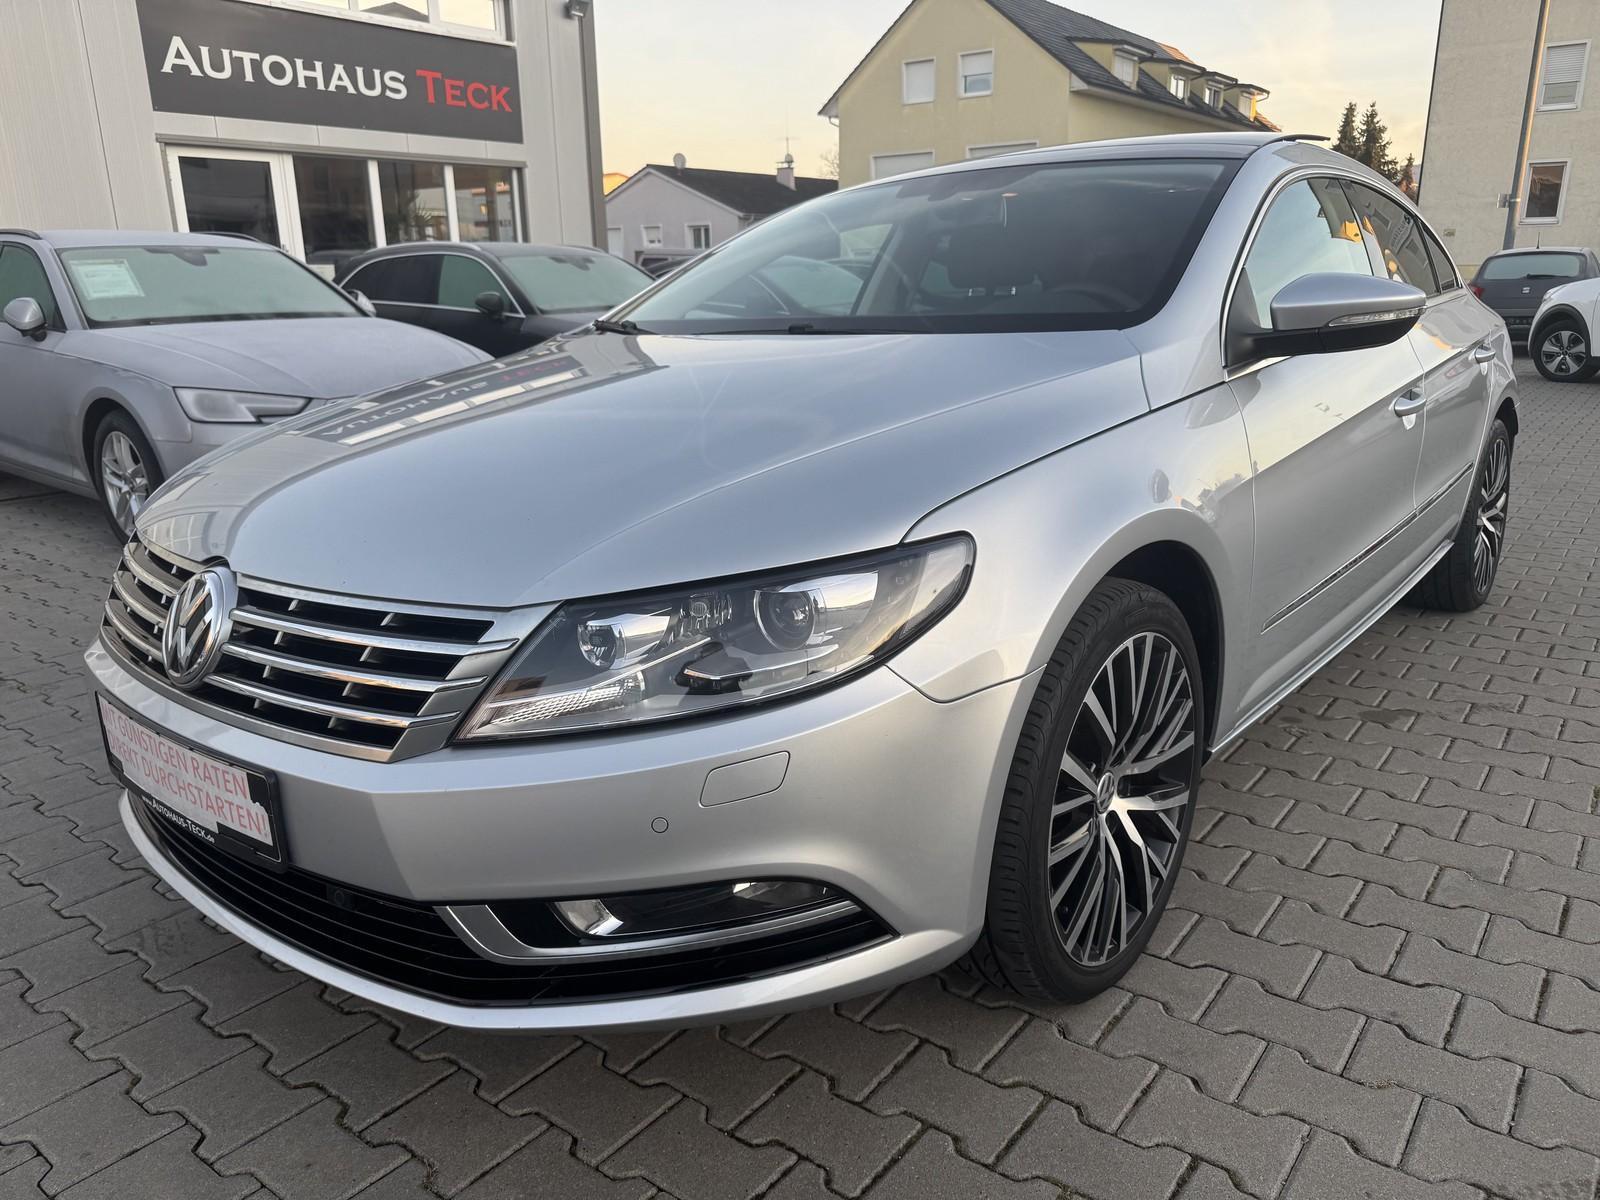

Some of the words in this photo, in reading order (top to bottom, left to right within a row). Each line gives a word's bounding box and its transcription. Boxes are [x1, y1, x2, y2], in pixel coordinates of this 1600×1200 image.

[161, 35, 408, 100] AUTOHAUS
[415, 69, 513, 113] TECK
[142, 757, 268, 838] DURCHSTARTEN!
[191, 757, 247, 799] RATEN
